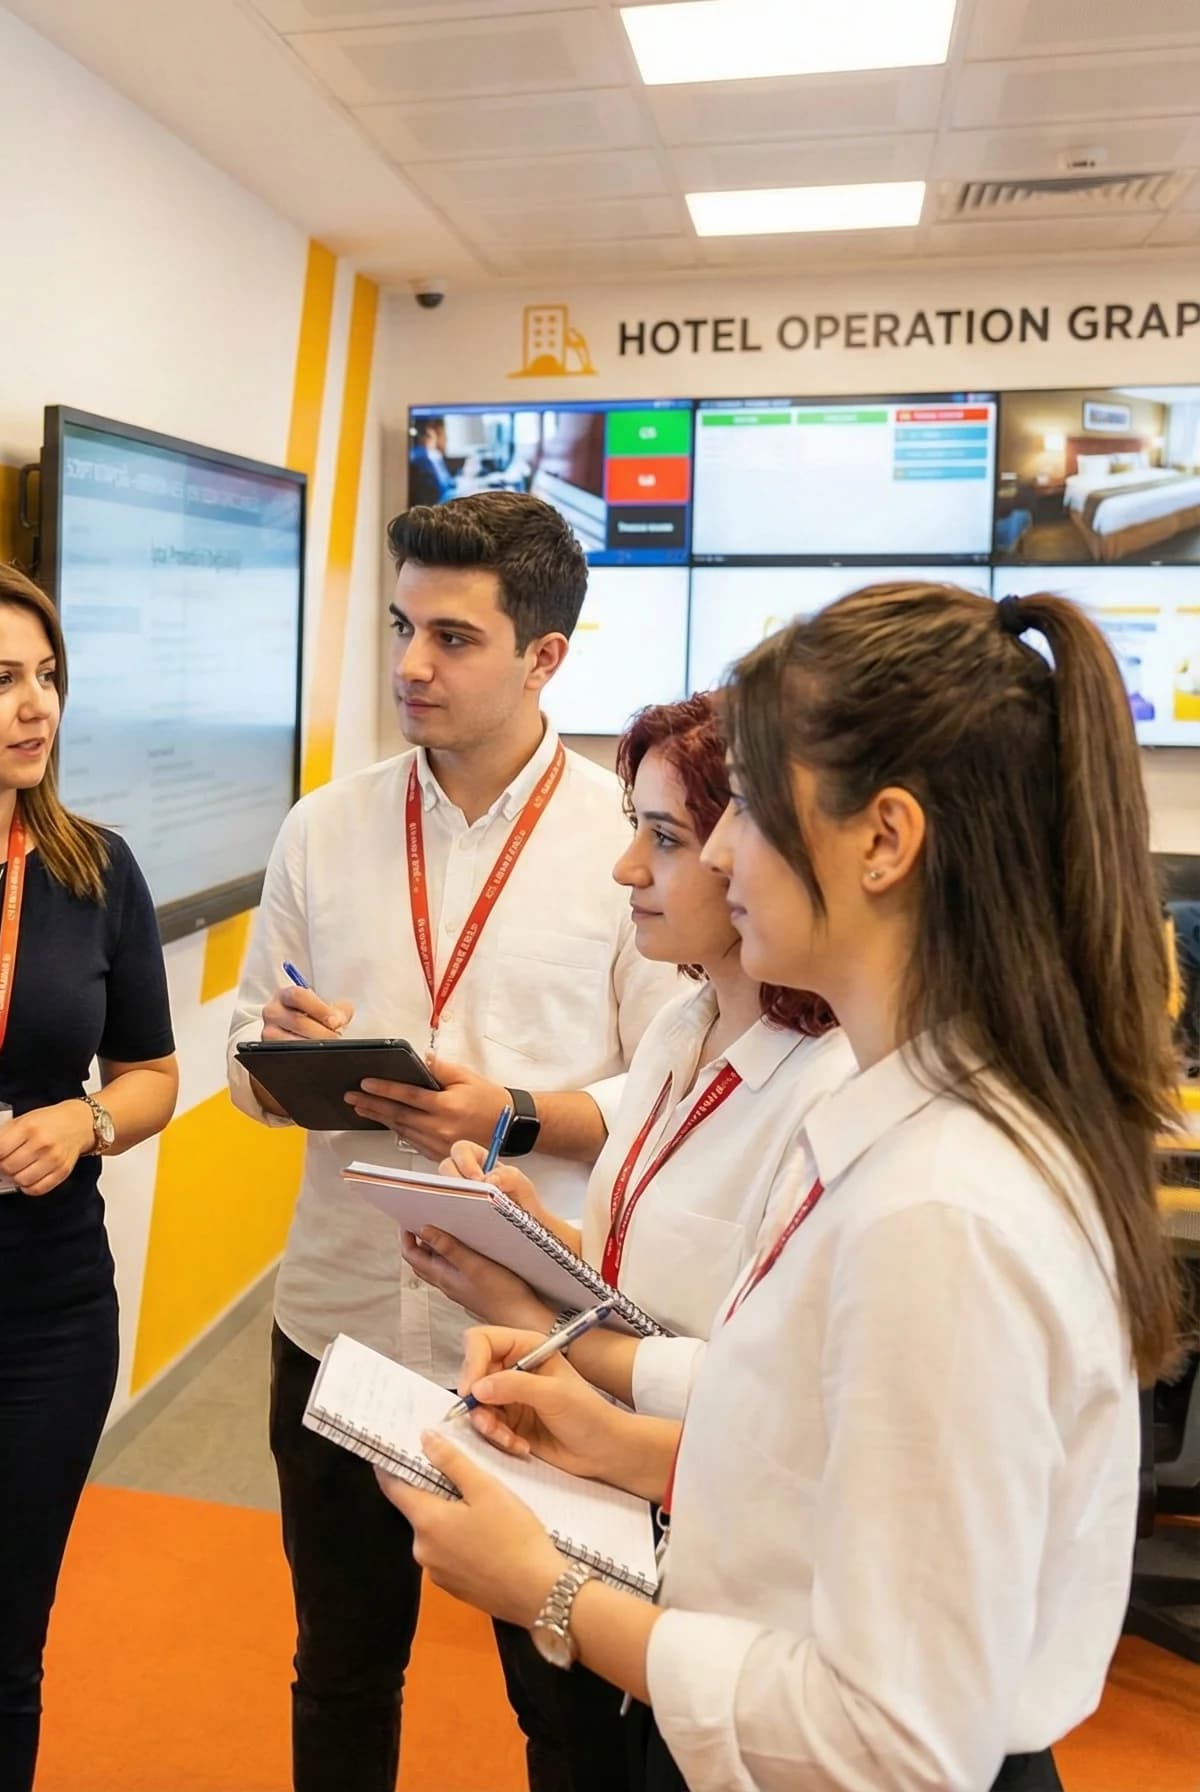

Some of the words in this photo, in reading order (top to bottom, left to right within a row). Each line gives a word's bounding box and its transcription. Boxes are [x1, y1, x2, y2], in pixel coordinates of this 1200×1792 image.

[619, 317, 762, 356] HOTEL
[776, 306, 1049, 351] OPERATION
[1067, 302, 1200, 341] GRAP
